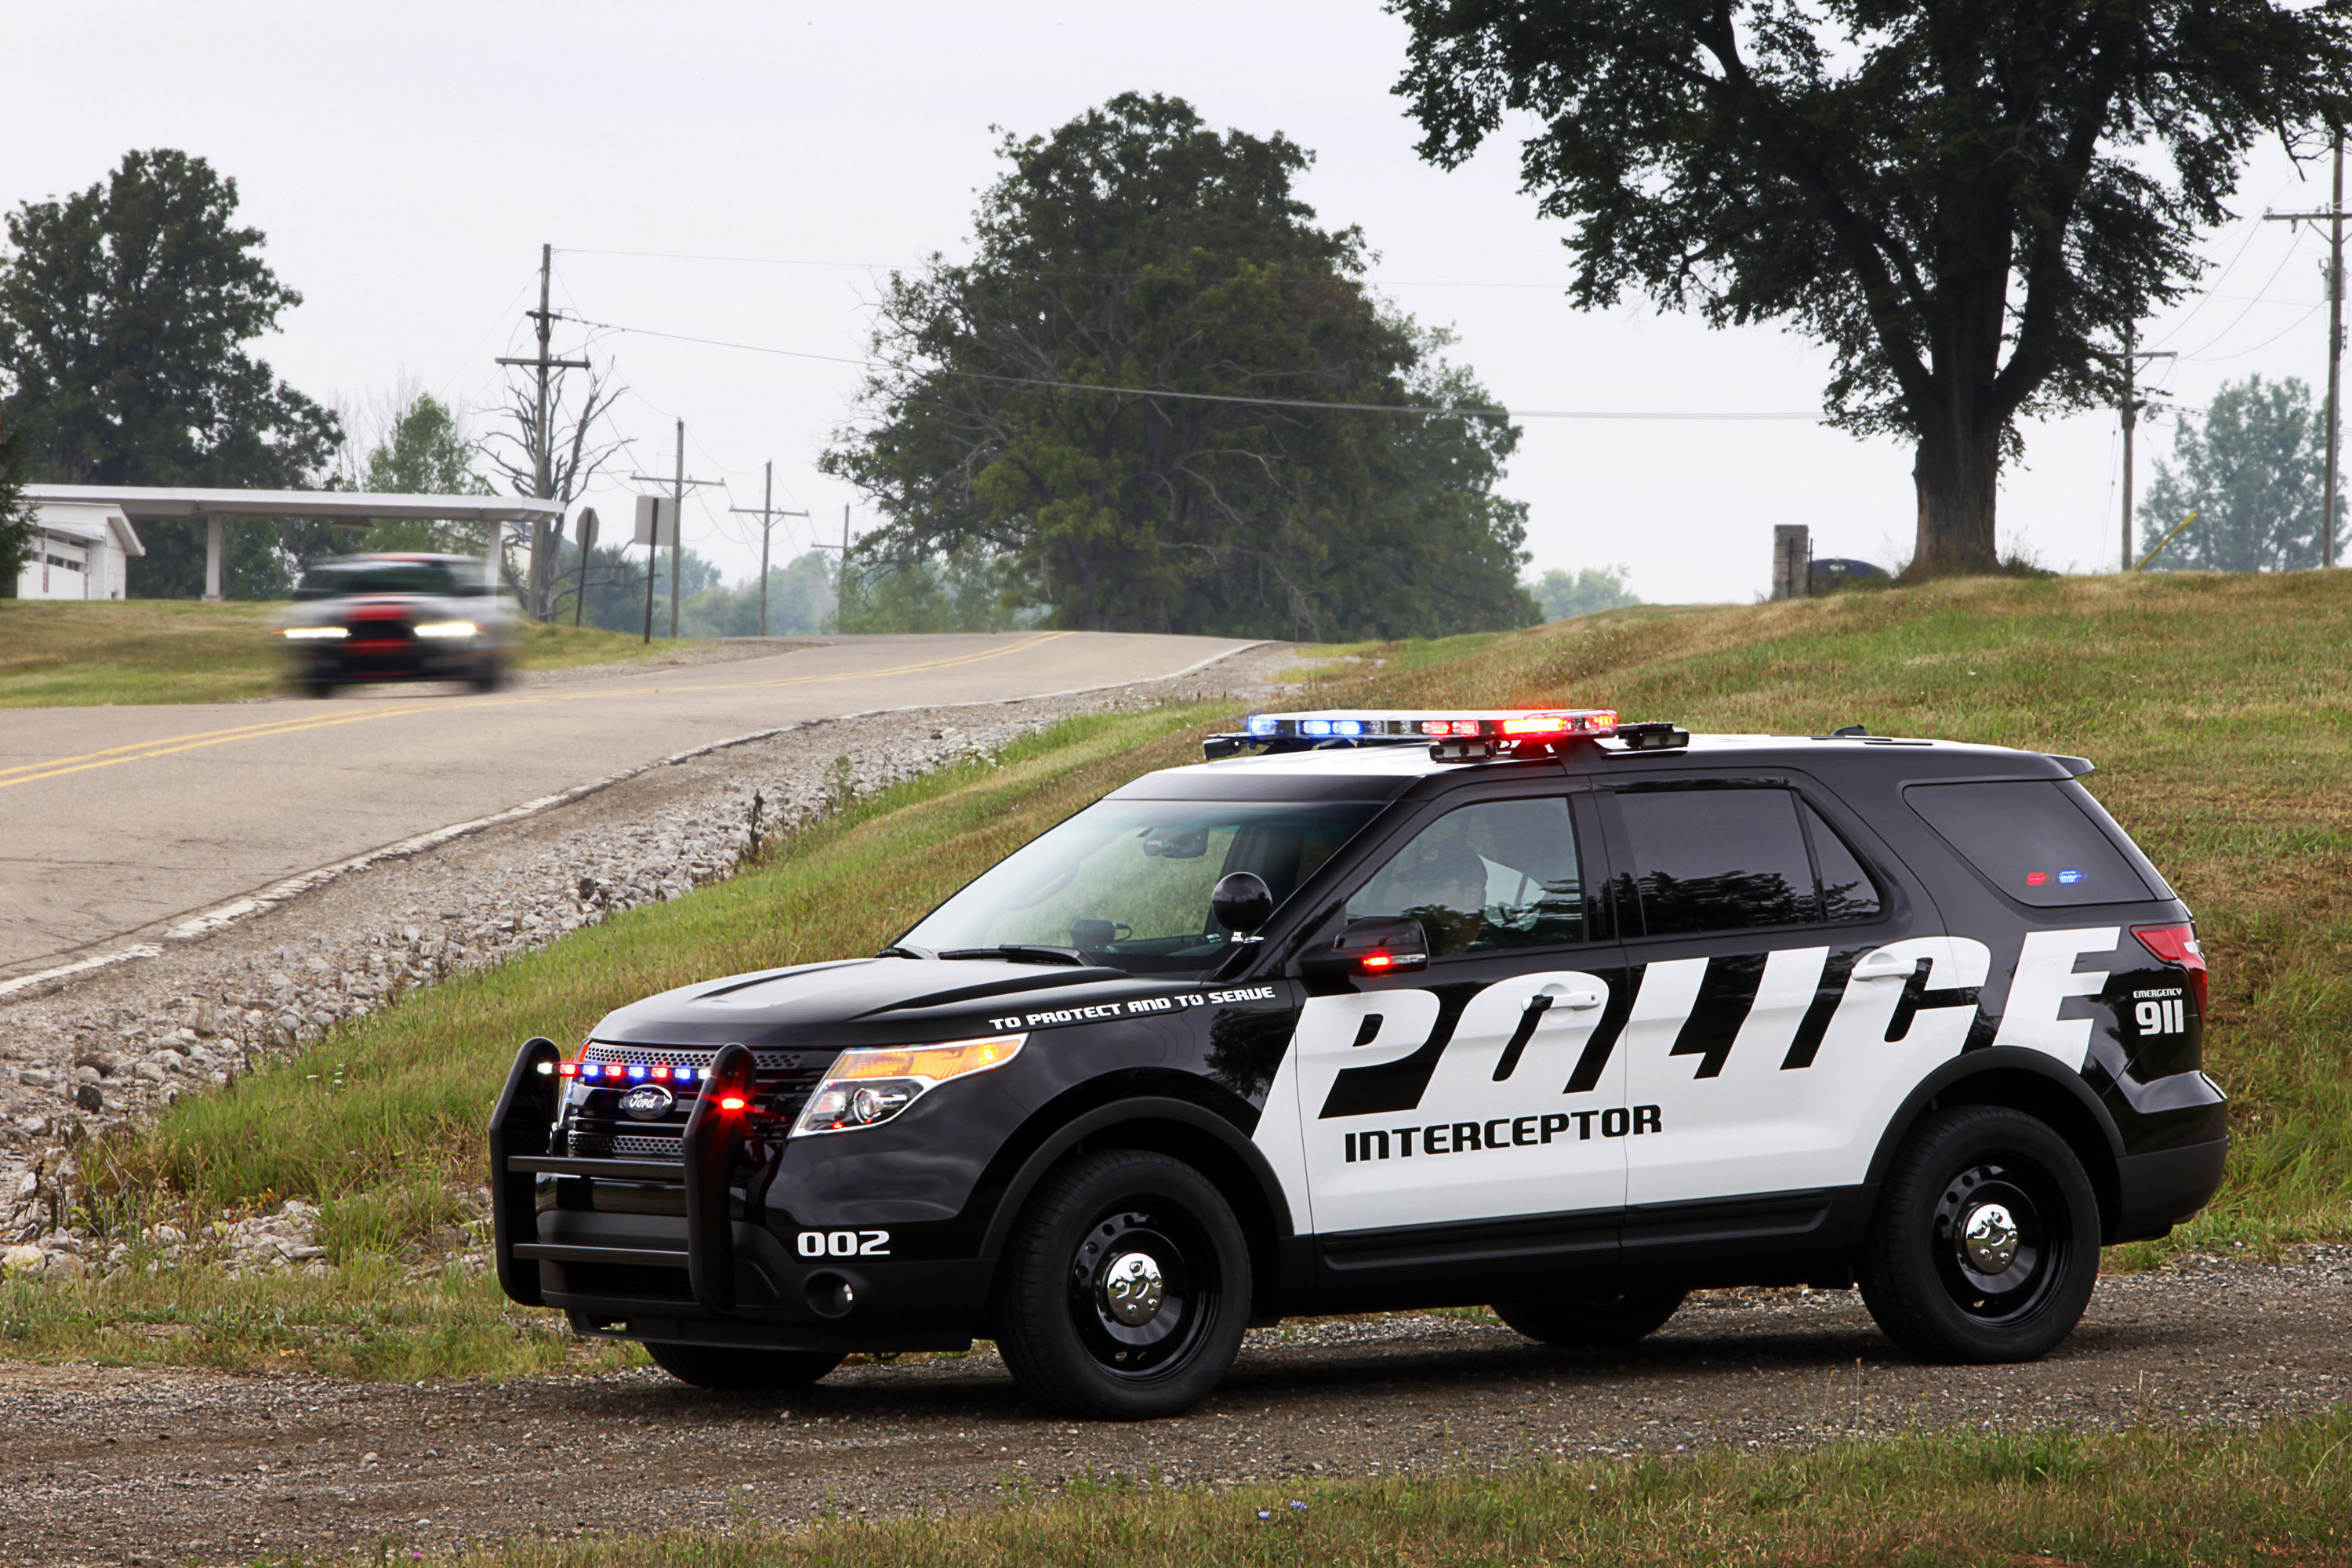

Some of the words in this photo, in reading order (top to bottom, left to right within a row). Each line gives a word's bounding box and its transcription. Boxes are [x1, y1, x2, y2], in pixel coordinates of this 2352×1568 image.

[989, 1017, 1022, 1030] TO
[1025, 1004, 1121, 1025] PROTECT
[1127, 997, 1171, 1013] AND
[1174, 994, 1204, 1007] TO
[1208, 986, 1276, 1004] SERVE
[2132, 988, 2183, 999] EMERGENCY
[1257, 927, 2121, 1121] POLICE
[2135, 999, 2184, 1036] 911
[630, 1090, 658, 1109] Ford
[1345, 1104, 1663, 1163] INTERCEPTOR
[797, 1230, 891, 1257] 002
